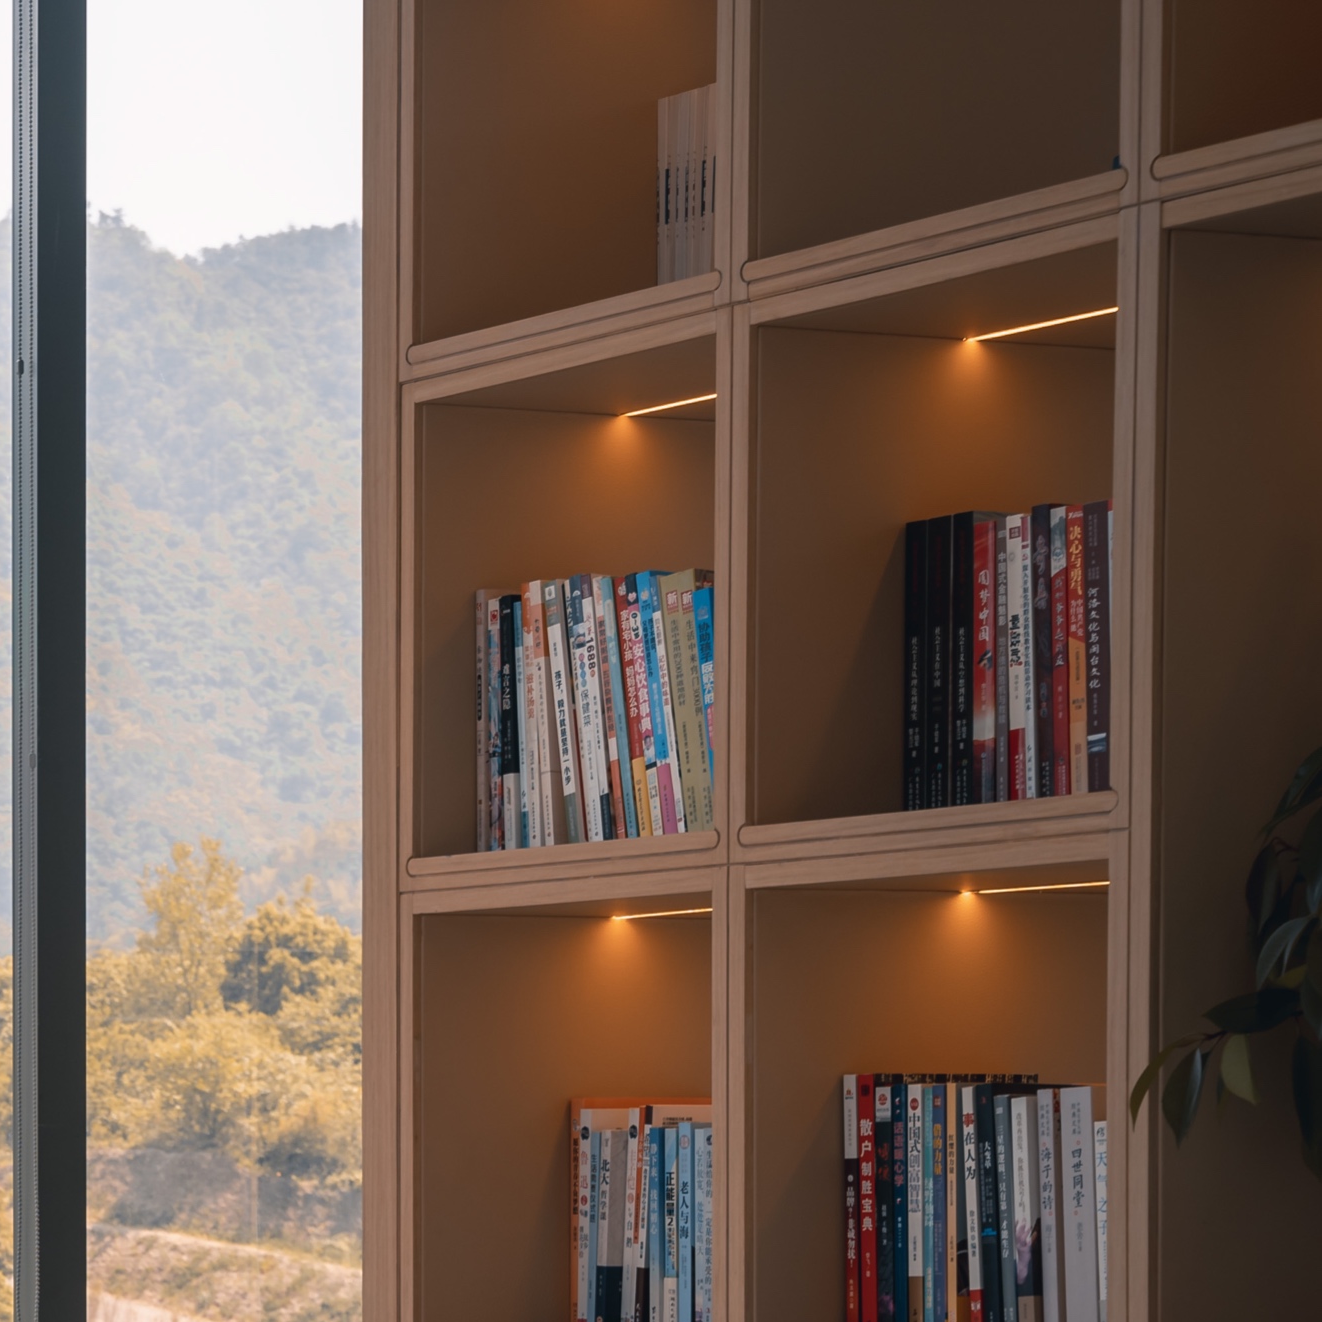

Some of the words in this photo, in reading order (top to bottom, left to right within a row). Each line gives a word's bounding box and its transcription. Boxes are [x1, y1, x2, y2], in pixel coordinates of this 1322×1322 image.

[1069, 525, 1083, 596] 决心与勇气
[1088, 587, 1101, 690] 河洛文化与闽台文化
[633, 643, 652, 733] 安心饮食事典
[580, 1150, 589, 1190] 鲁迅
[859, 1118, 874, 1232] 散户制胜宝典
[908, 1112, 922, 1214] 中国式创富智慧
[962, 1112, 977, 1182] 事在人为
[1041, 1146, 1055, 1211] 海子的诗
[1071, 1147, 1086, 1209] 四世同堂
[679, 1180, 690, 1240] 老人与海
